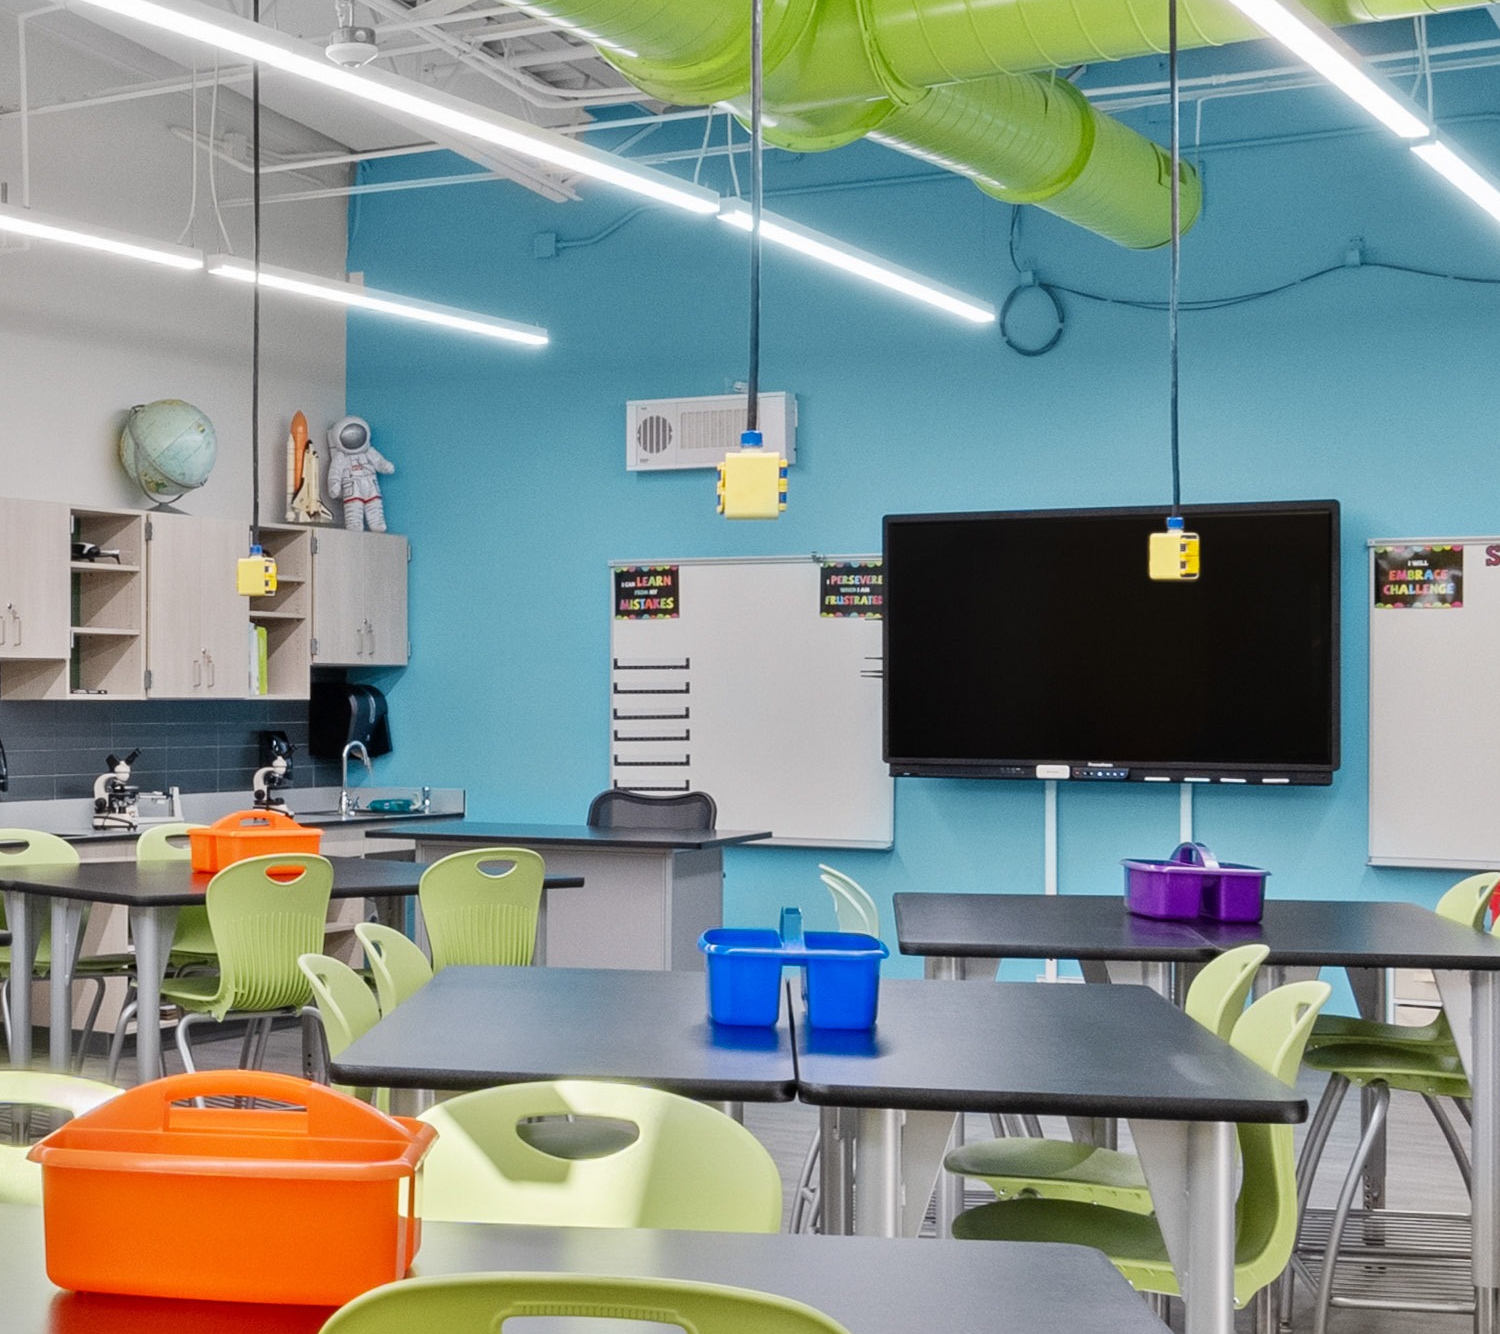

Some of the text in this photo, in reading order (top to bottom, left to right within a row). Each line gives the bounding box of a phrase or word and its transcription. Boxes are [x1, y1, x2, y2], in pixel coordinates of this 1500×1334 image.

[636, 575, 672, 587] LEARN
[831, 575, 883, 585] PERSEVERE
[1389, 569, 1449, 581] EMBRACE
[1383, 583, 1455, 595] CHALLENGE
[620, 597, 674, 610] MISTAKES
